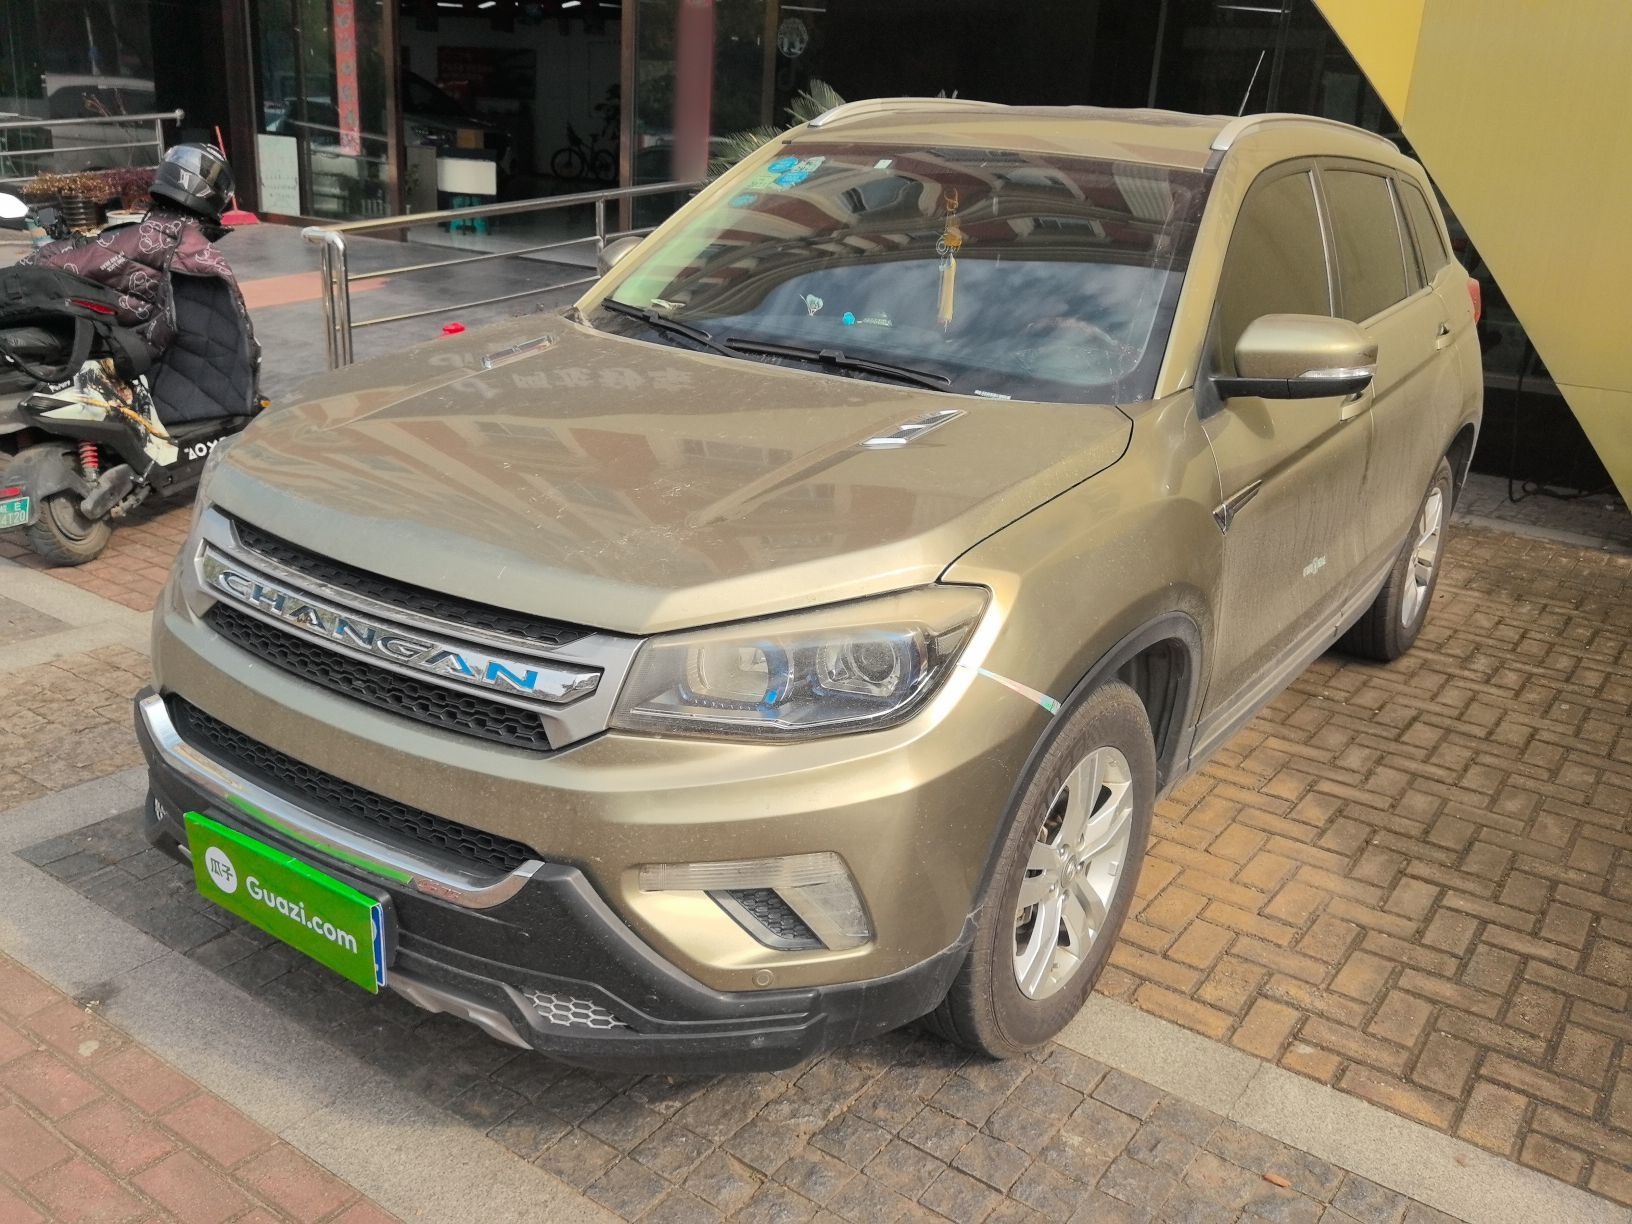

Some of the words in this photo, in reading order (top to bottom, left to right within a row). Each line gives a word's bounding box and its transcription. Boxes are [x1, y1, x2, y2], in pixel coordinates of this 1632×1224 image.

[218, 570, 538, 693] CHANGAN
[210, 857, 233, 881] 瓜子
[246, 876, 358, 954] Guazi.com
